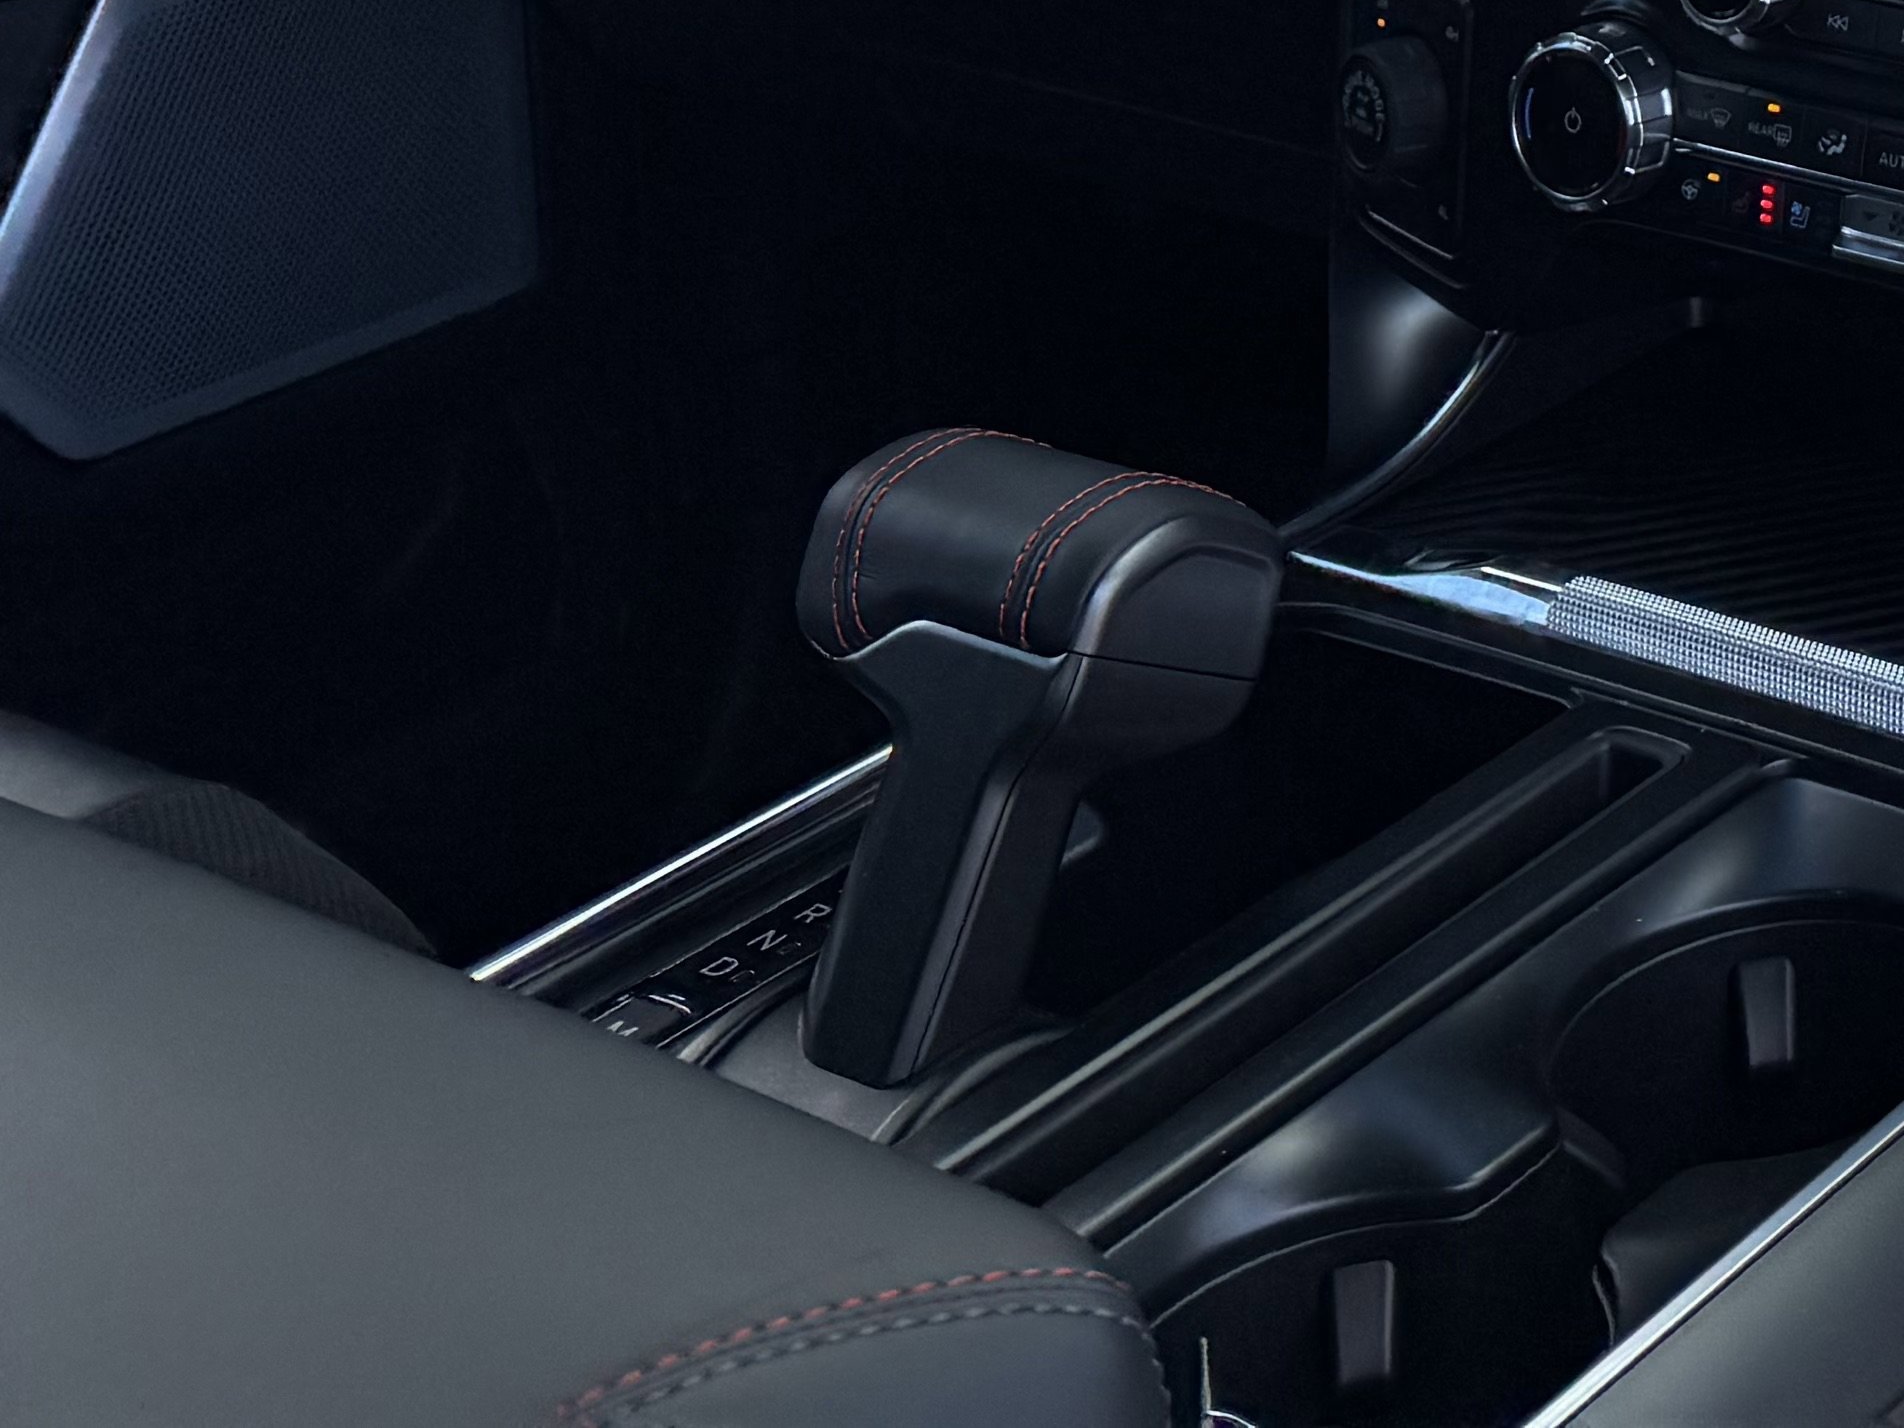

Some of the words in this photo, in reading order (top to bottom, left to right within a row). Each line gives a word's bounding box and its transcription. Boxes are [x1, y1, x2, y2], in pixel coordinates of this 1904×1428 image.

[793, 902, 833, 924] R
[746, 929, 788, 951] N
[699, 956, 740, 977] D
